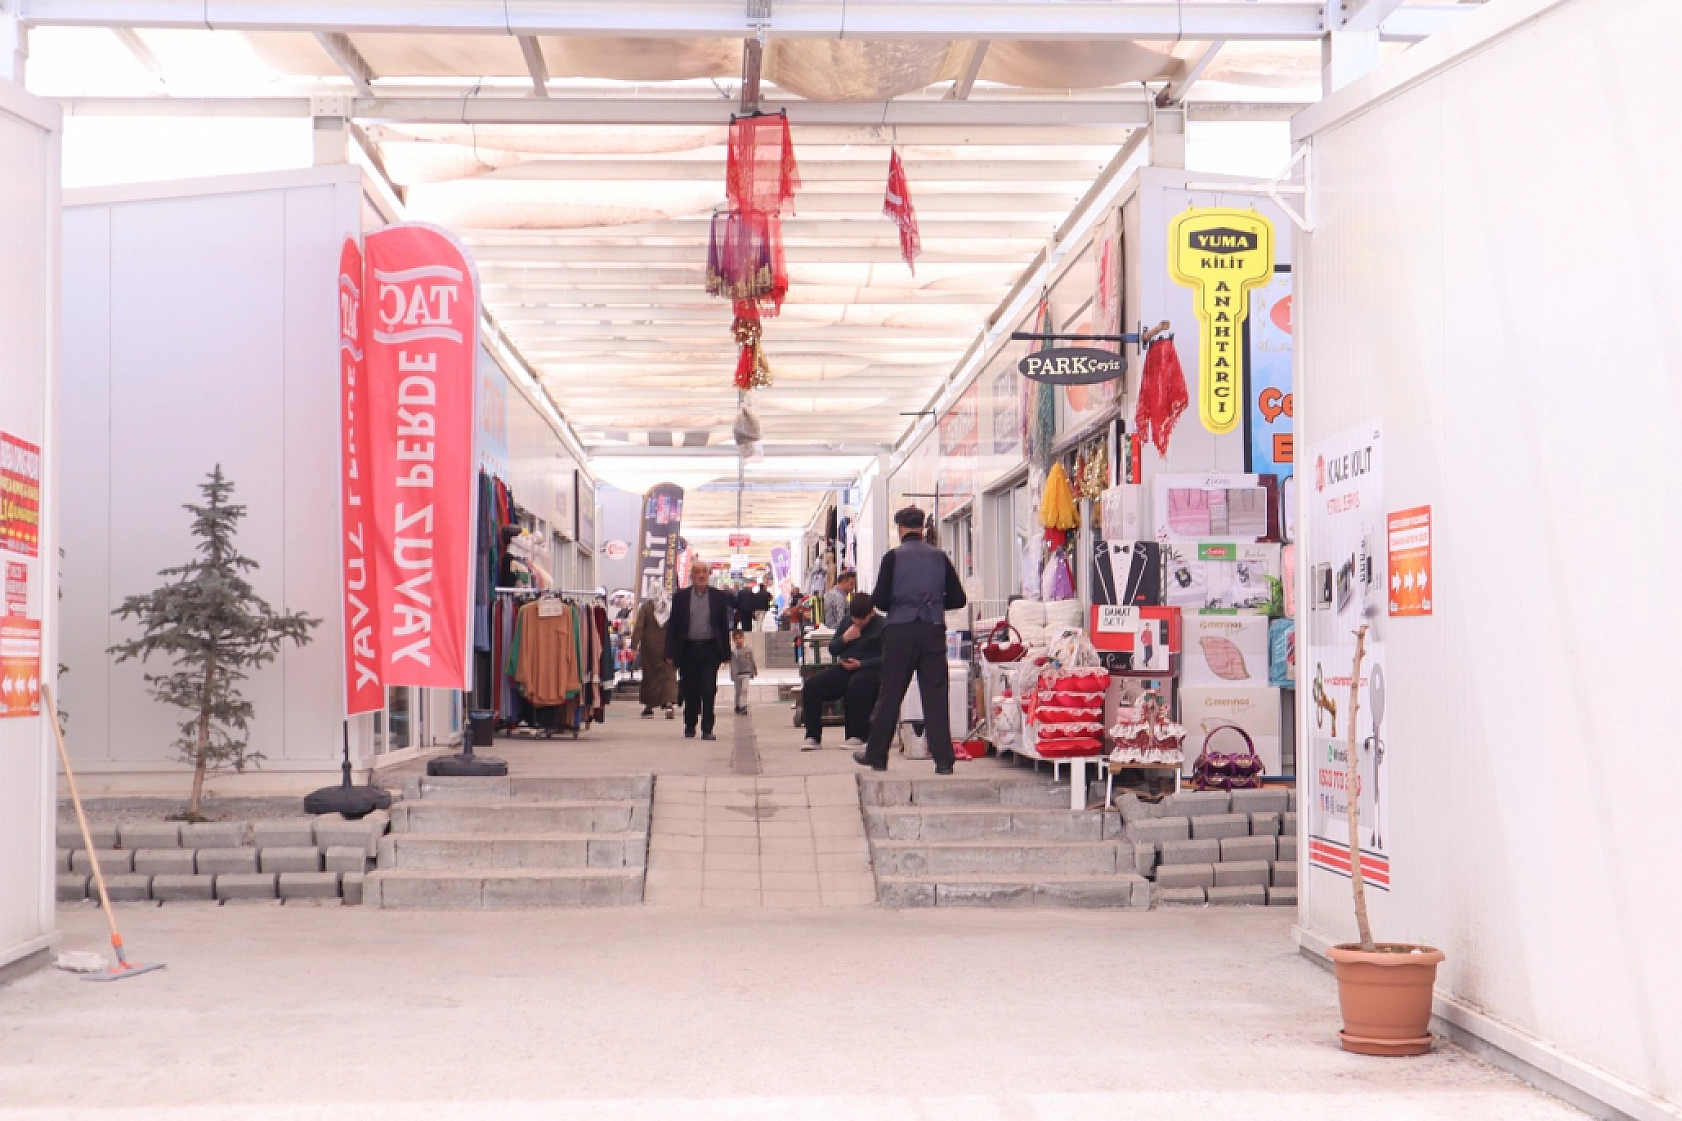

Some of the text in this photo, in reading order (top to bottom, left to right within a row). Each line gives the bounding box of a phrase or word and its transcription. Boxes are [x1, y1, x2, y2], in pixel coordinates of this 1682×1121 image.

[1197, 234, 1250, 248] YUMA
[1201, 254, 1245, 269] KİLİT
[1214, 281, 1231, 413] ANAHTARCI
[1027, 356, 1121, 375] PARK Çeyiz
[347, 522, 380, 692] YAVUZ
